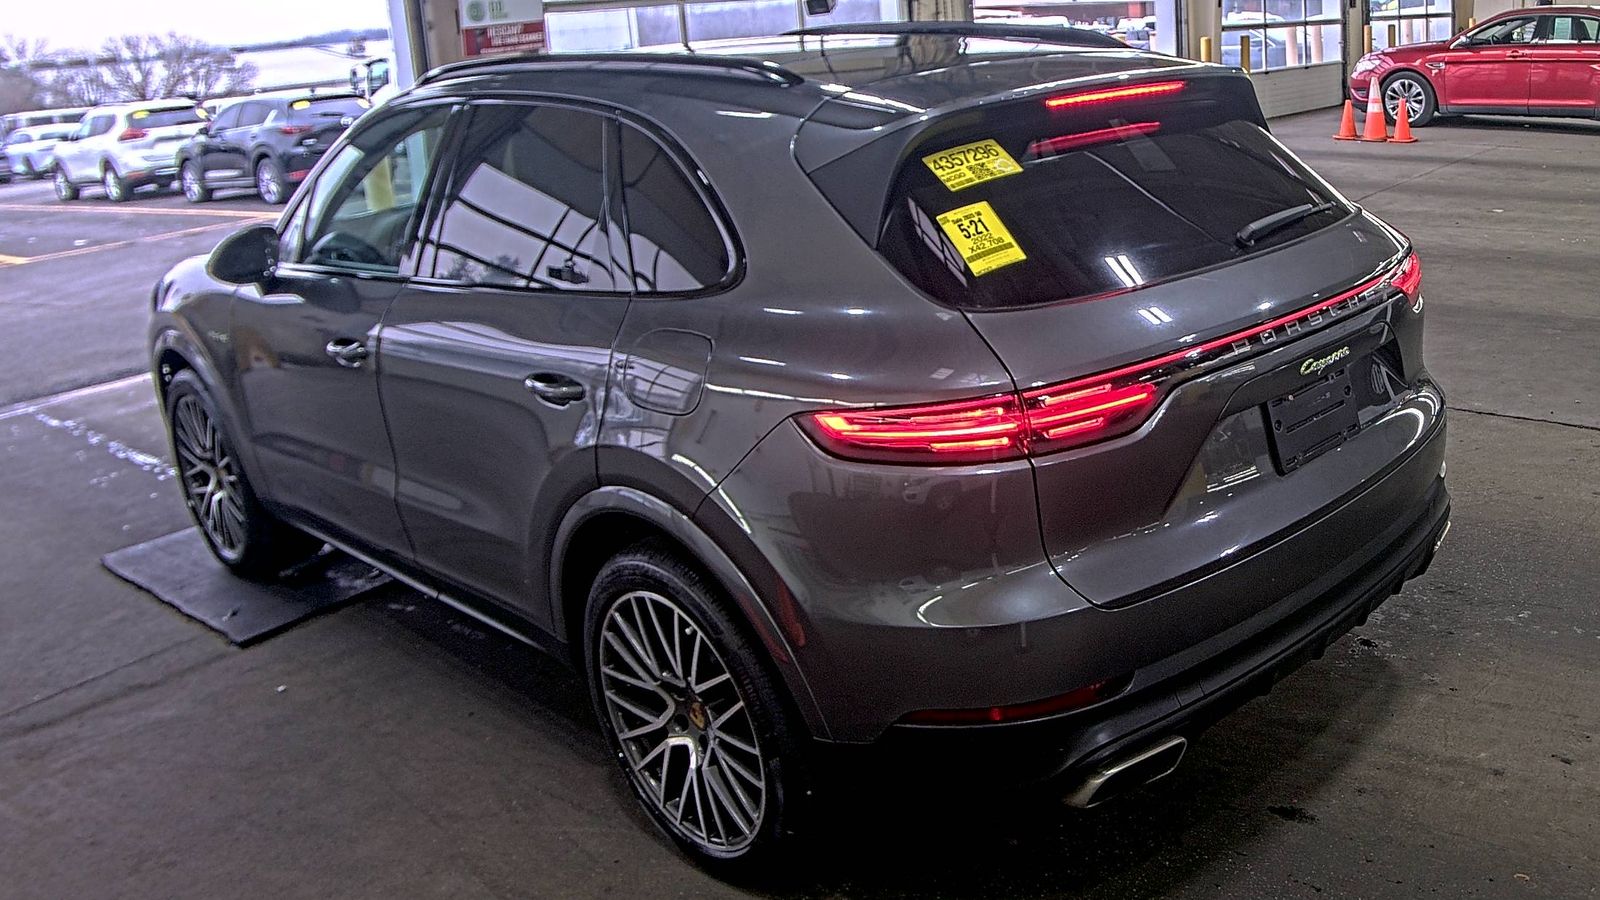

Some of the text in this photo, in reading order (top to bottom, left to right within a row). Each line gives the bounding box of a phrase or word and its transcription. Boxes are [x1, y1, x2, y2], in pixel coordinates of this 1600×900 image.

[932, 144, 999, 172] 4357296
[957, 217, 990, 239] 5:21
[1231, 290, 1377, 354] PORSCHE
[1300, 346, 1350, 376] Cayenne
